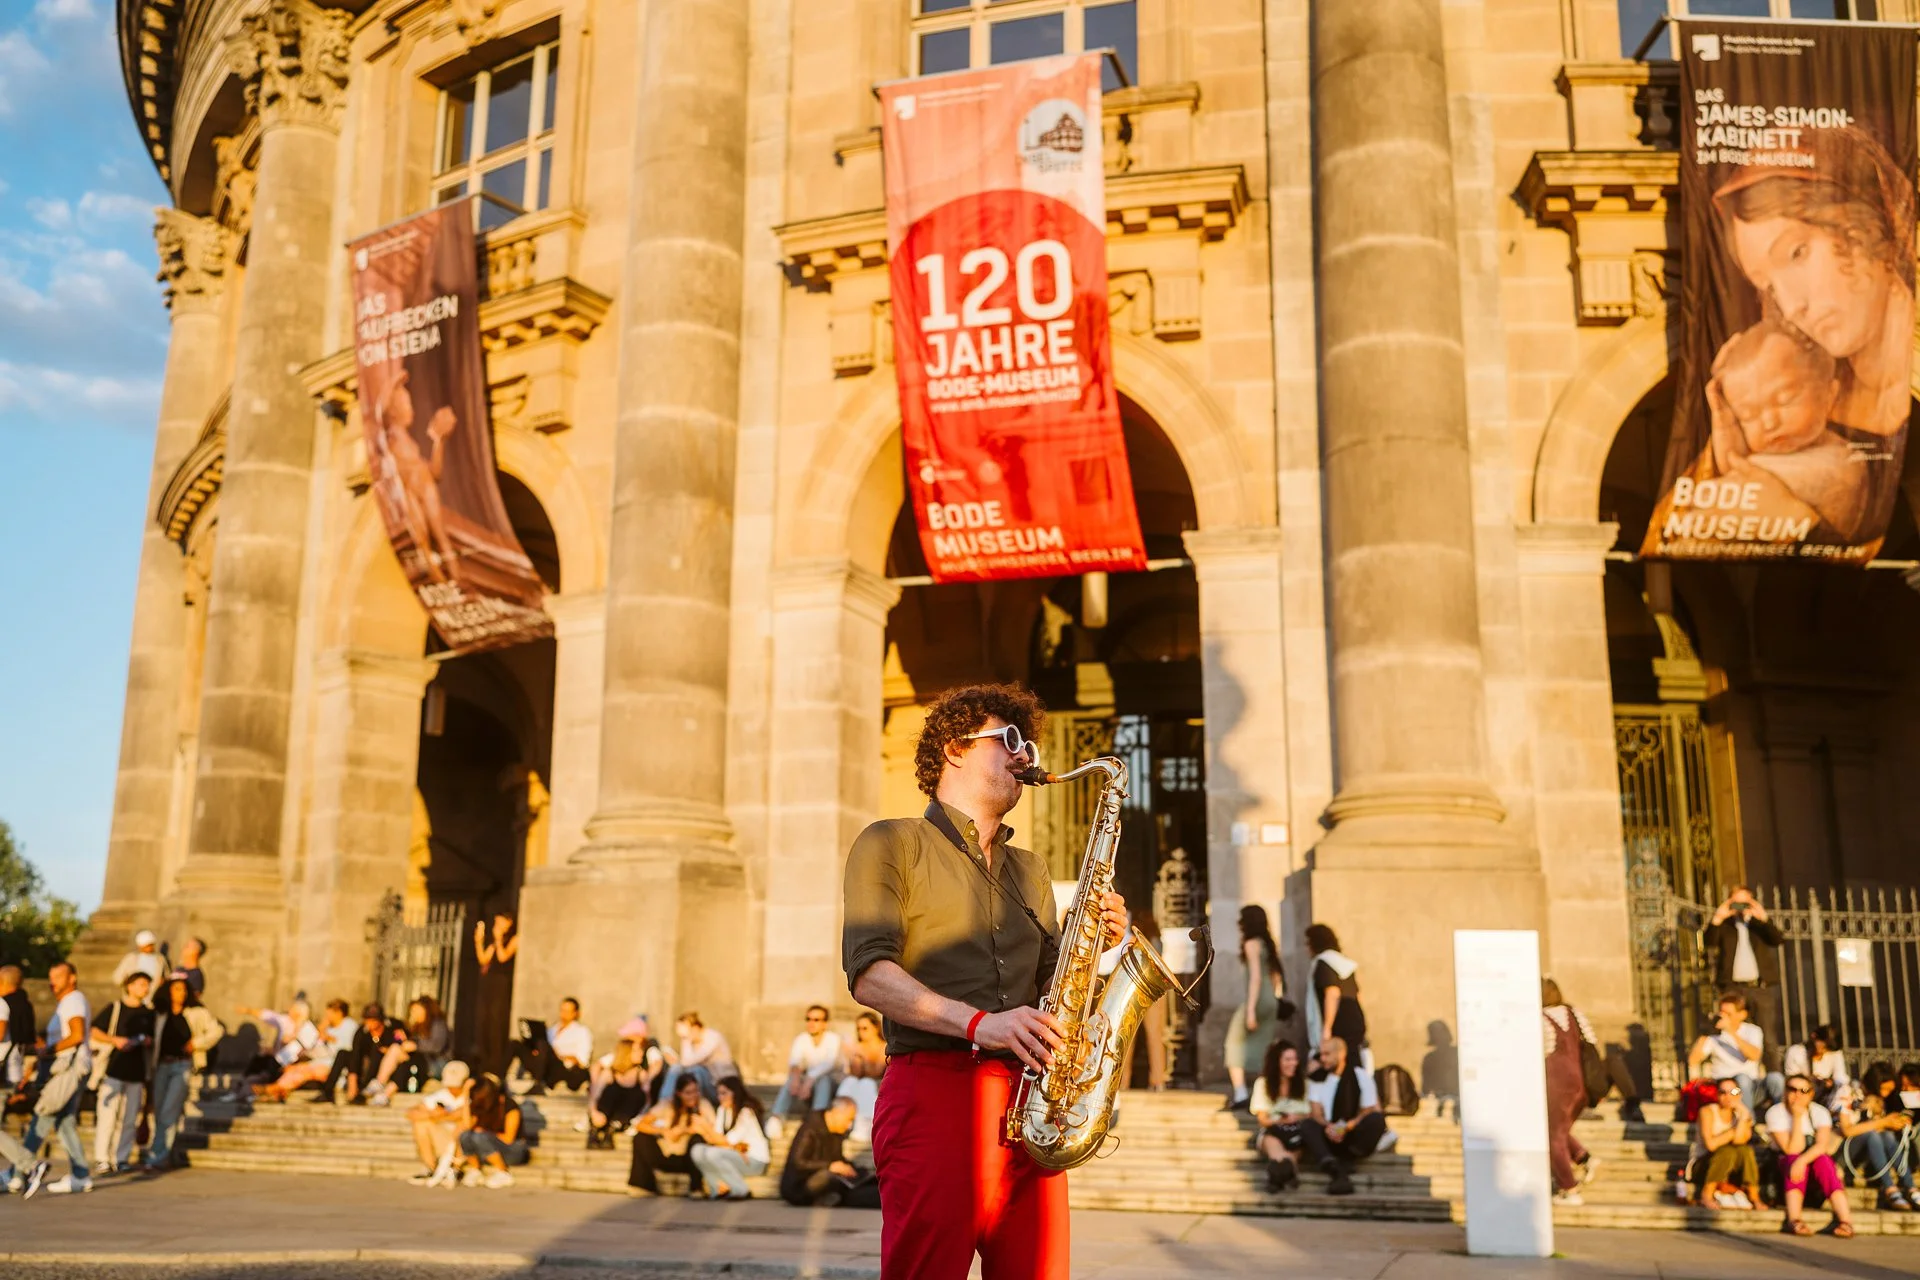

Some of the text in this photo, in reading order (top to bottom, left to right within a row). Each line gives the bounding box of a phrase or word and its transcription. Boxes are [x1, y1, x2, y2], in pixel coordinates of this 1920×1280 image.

[1694, 87, 1725, 104] DAS
[1695, 104, 1855, 129] JAMES-SIMON-
[1696, 126, 1802, 150] KABINETT
[1696, 149, 1816, 168] IM BODE-MUSEUM
[915, 239, 1074, 332] 120
[358, 339, 389, 367] ON
[925, 319, 1078, 378] JAHRE
[926, 366, 1080, 400] BODE-MUSEUM
[1673, 476, 1763, 511] BODE
[927, 500, 1005, 531] BODE
[1663, 511, 1812, 542] MUSEUM
[933, 526, 1065, 559] MUSEUM
